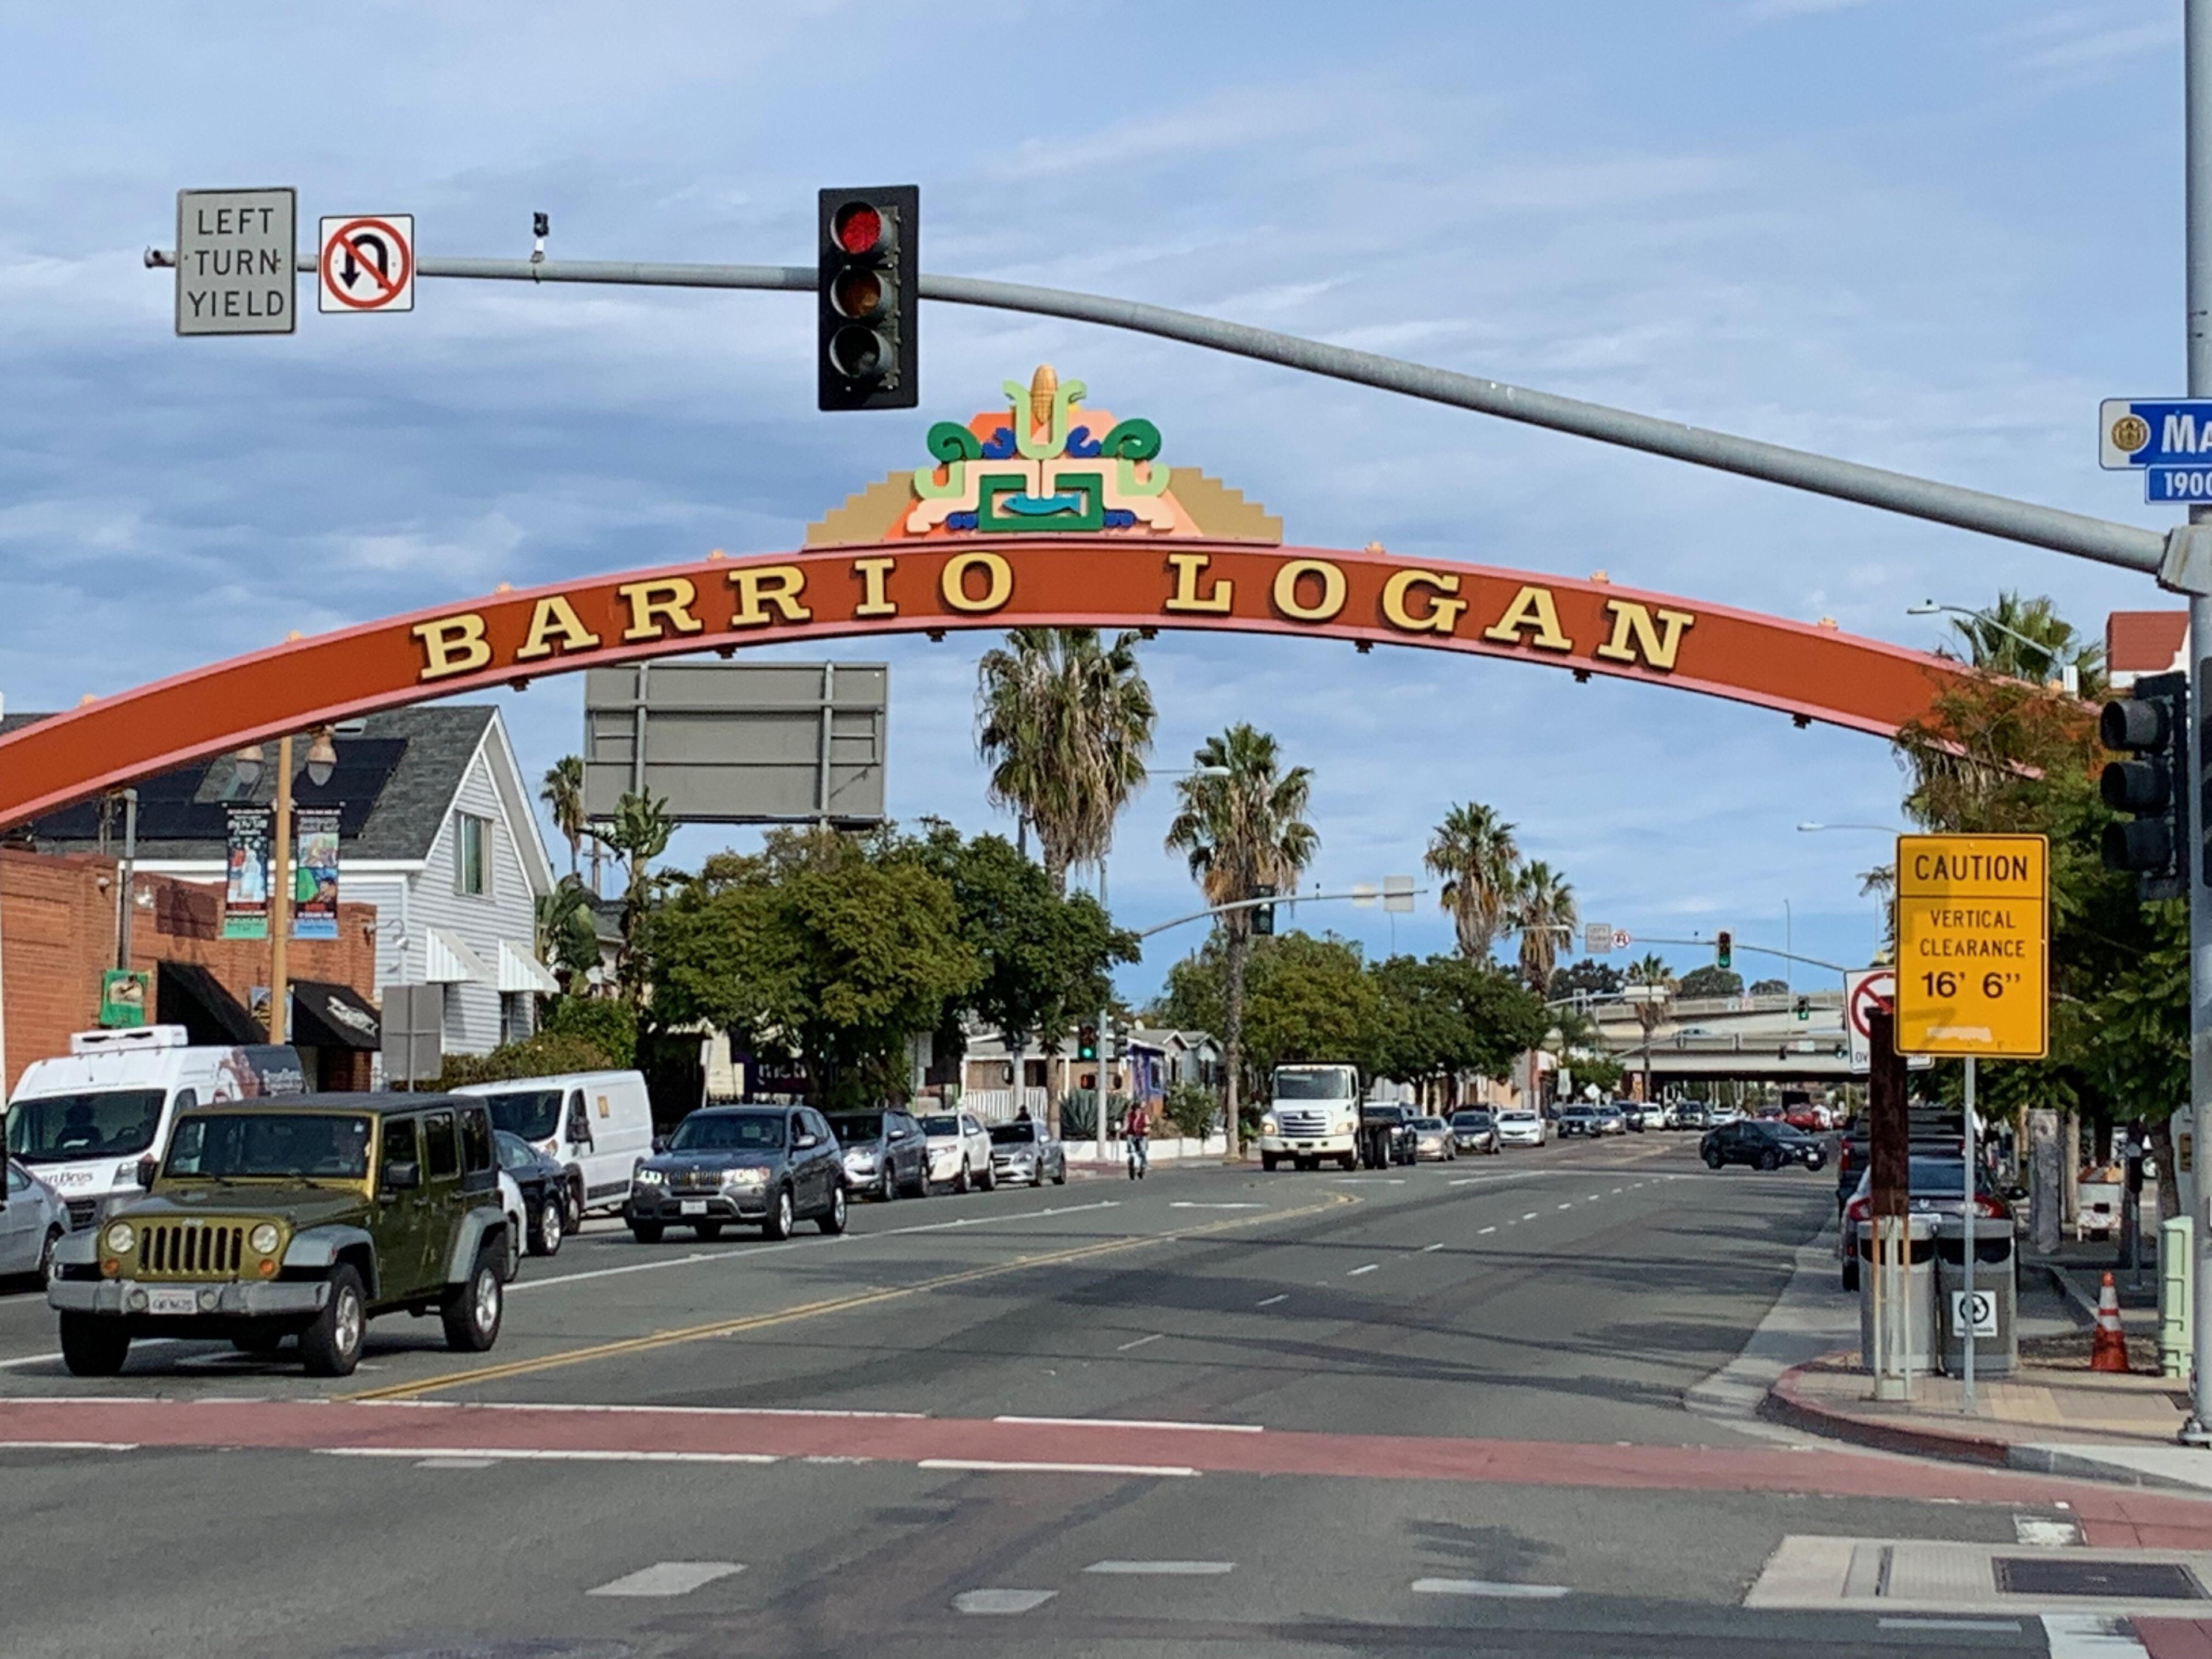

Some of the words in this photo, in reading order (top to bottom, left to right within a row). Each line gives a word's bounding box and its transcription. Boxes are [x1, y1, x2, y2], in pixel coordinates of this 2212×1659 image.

[199, 208, 274, 235] LEFT
[195, 249, 278, 275] TURN
[187, 291, 284, 317] YIELD
[412, 551, 1014, 680] BARRIO
[1165, 553, 1694, 671] LOGAN
[1915, 855, 2027, 881] CAUTION
[1930, 910, 2016, 928] VERTICAL
[1920, 938, 2025, 957] CLEARANCE
[1921, 972, 1965, 998] 16'
